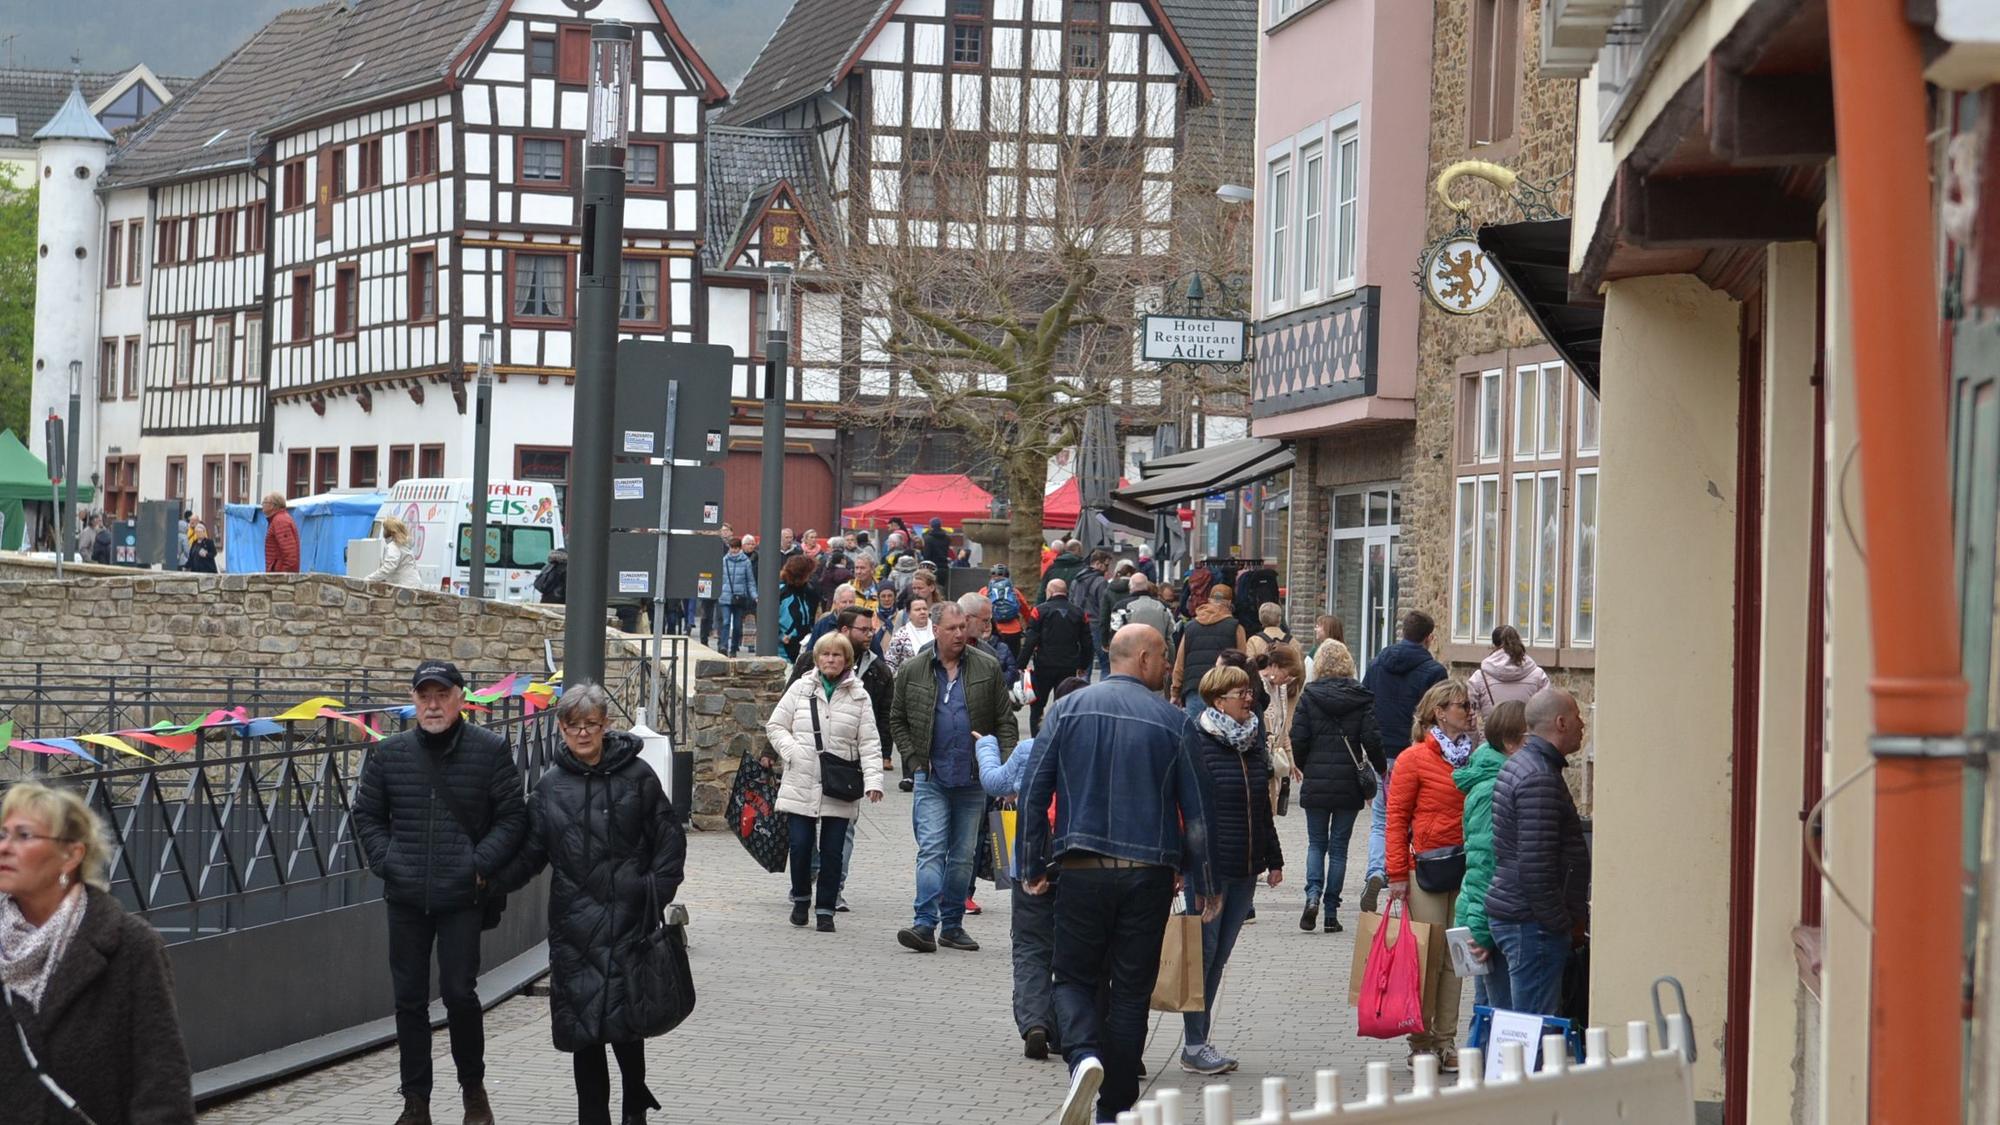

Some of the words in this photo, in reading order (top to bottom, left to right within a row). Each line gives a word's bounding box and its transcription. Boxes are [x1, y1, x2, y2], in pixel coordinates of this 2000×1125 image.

[1174, 321, 1215, 332] Hotel
[1154, 331, 1235, 344] Restaurant
[1171, 344, 1225, 358] Adler
[488, 484, 532, 496] TALIA
[486, 499, 526, 515] EIS
